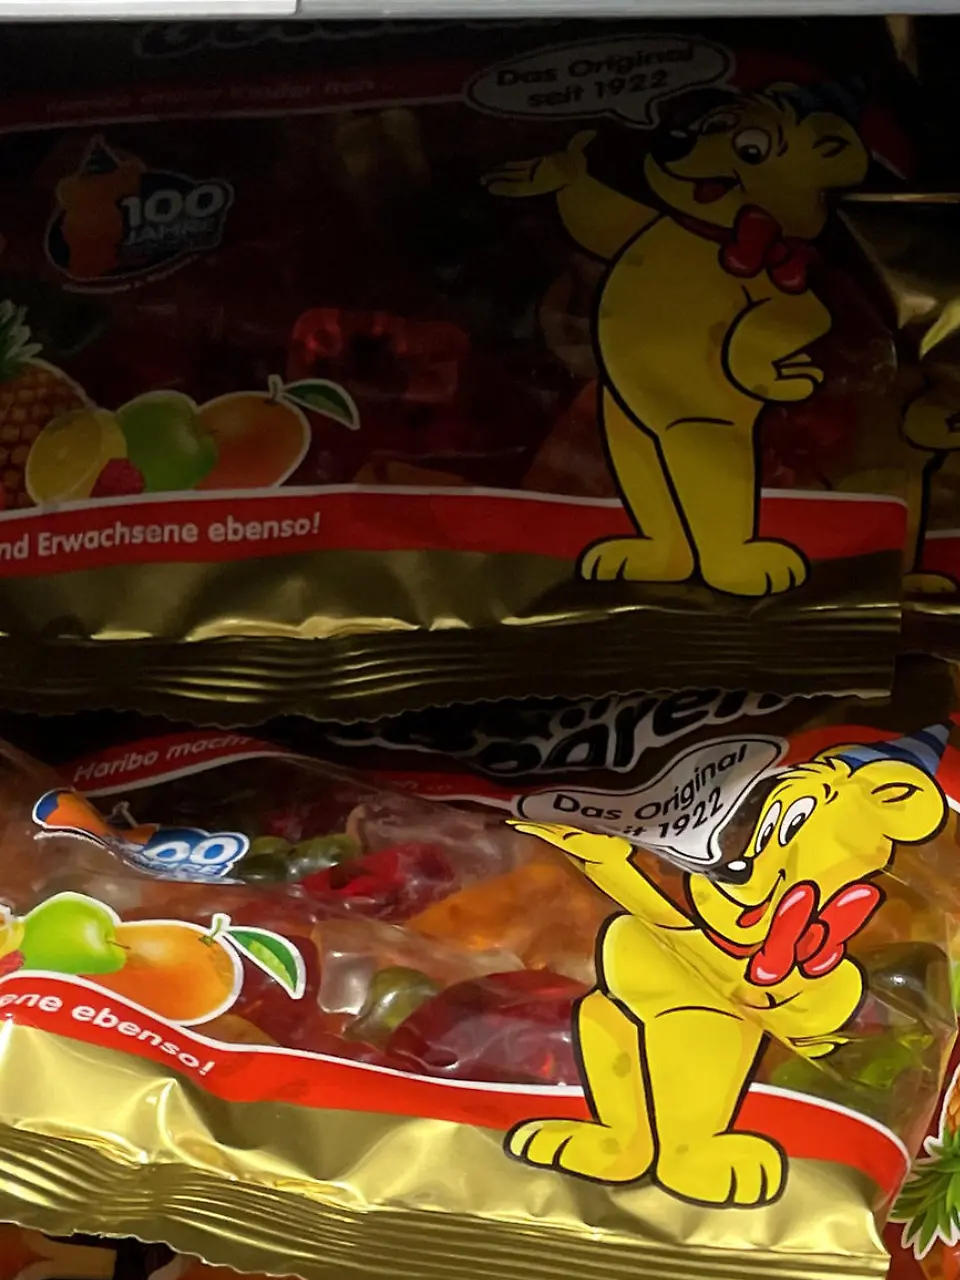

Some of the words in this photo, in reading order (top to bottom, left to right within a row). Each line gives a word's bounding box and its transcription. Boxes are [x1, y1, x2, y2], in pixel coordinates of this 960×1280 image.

[496, 68, 558, 85] Das
[567, 44, 696, 77] Original
[529, 83, 585, 106] seit
[594, 69, 668, 99] 1922
[120, 185, 226, 228] 100
[0, 534, 29, 558] nd
[37, 521, 199, 556] Erwachsene
[207, 511, 320, 542] ebenso!
[72, 750, 159, 783] Haribo
[553, 794, 621, 820] Das
[633, 744, 748, 820] Original
[657, 787, 724, 839] 1922
[0, 992, 63, 1012] ene
[71, 1005, 215, 1076] ebenso!
